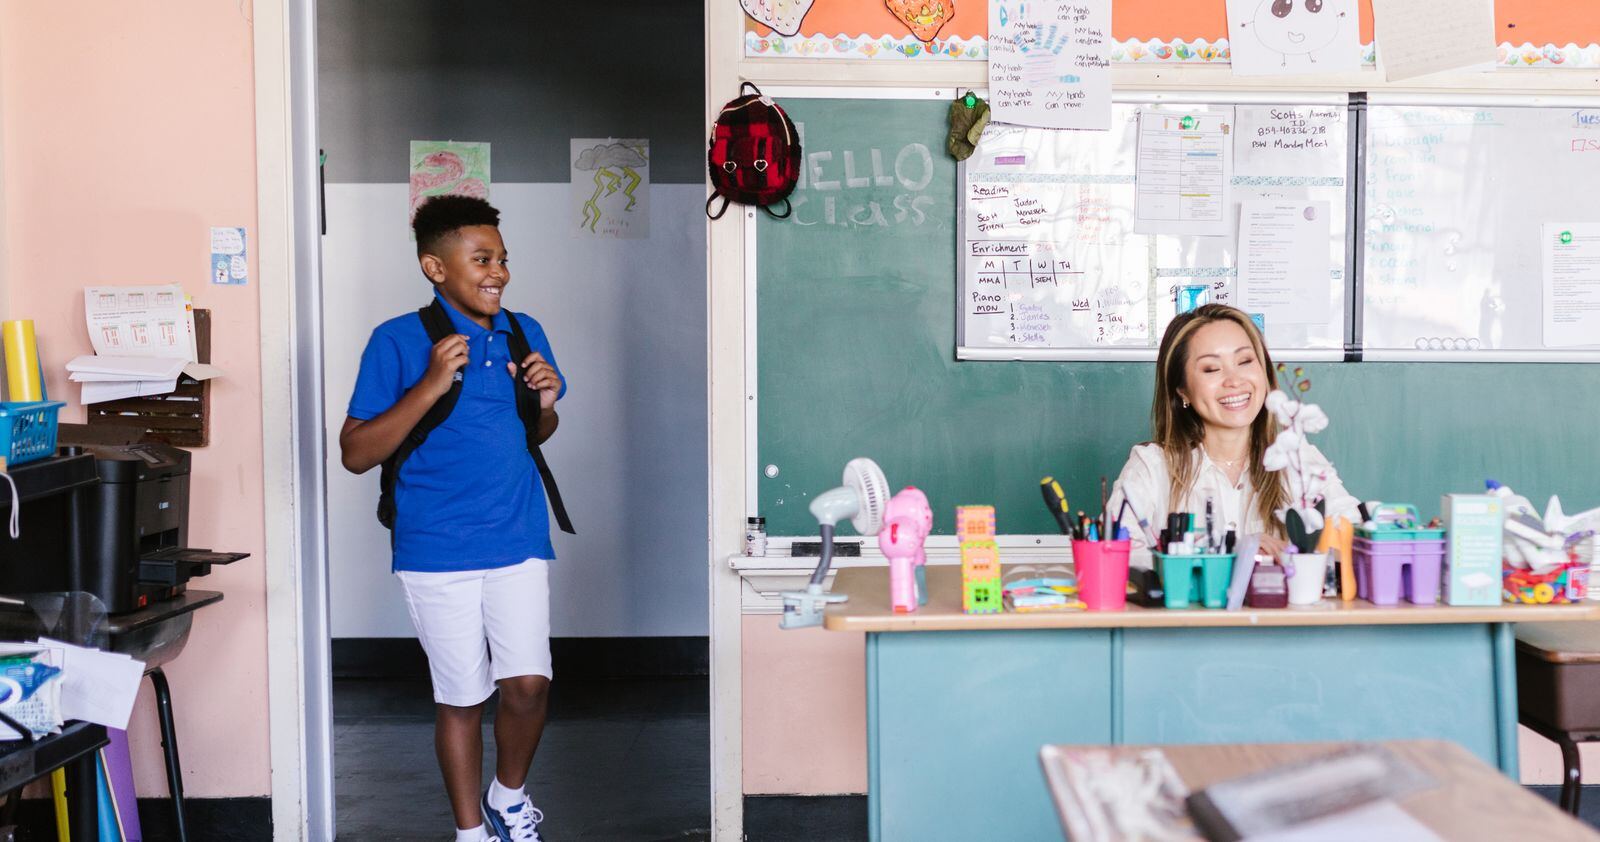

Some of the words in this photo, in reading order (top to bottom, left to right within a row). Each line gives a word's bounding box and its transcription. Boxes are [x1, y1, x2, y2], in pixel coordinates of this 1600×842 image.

[795, 122, 934, 192] ELLO
[971, 184, 1010, 196] Reading
[971, 244, 1029, 254] Enrichment
[984, 260, 995, 269] M
[1013, 260, 1022, 271] T
[1037, 260, 1047, 269] W
[1059, 261, 1071, 270] TH
[976, 304, 999, 312] MON
[1072, 298, 1090, 308] Wed
